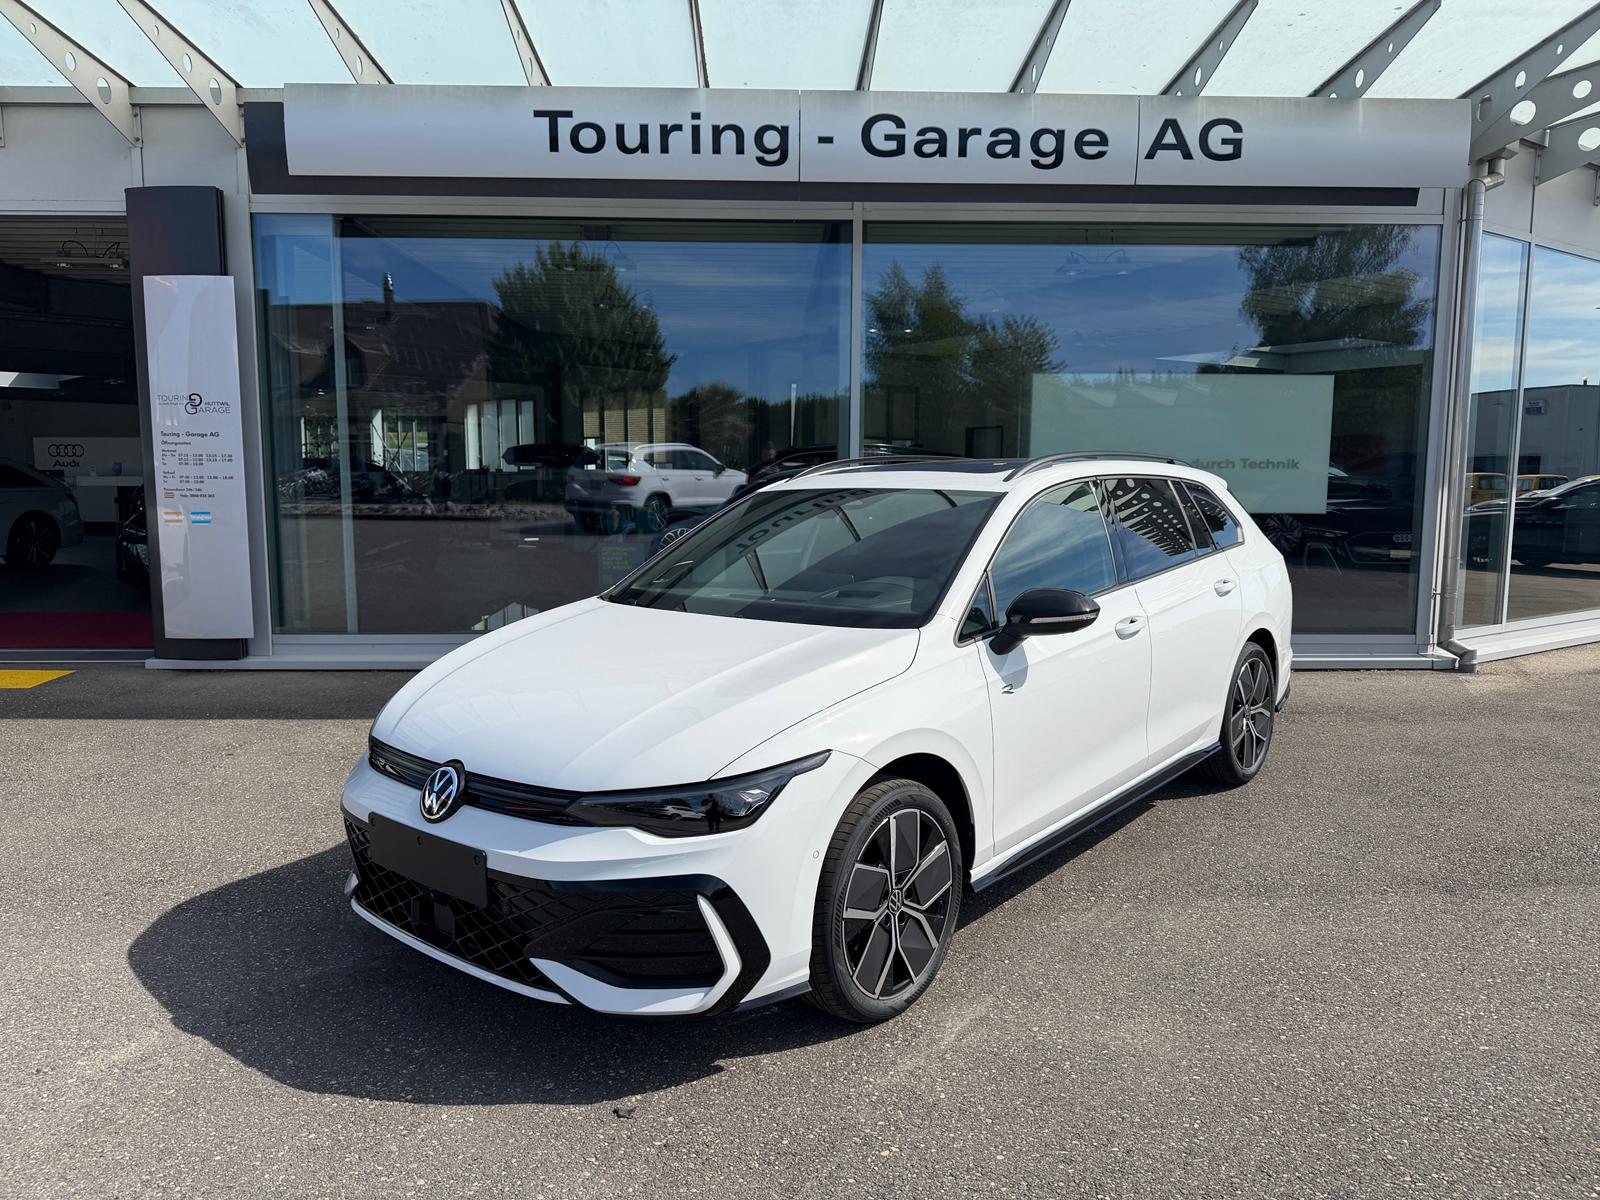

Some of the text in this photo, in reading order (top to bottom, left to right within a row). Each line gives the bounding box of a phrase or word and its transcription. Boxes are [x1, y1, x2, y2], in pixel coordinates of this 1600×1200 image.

[533, 109, 790, 167] Touring
[861, 113, 1109, 170] Garage
[1144, 117, 1243, 162] AG
[160, 430, 180, 438] Touring
[185, 430, 208, 439] Garage
[53, 459, 80, 467] Audi
[1240, 458, 1300, 471] Technik
